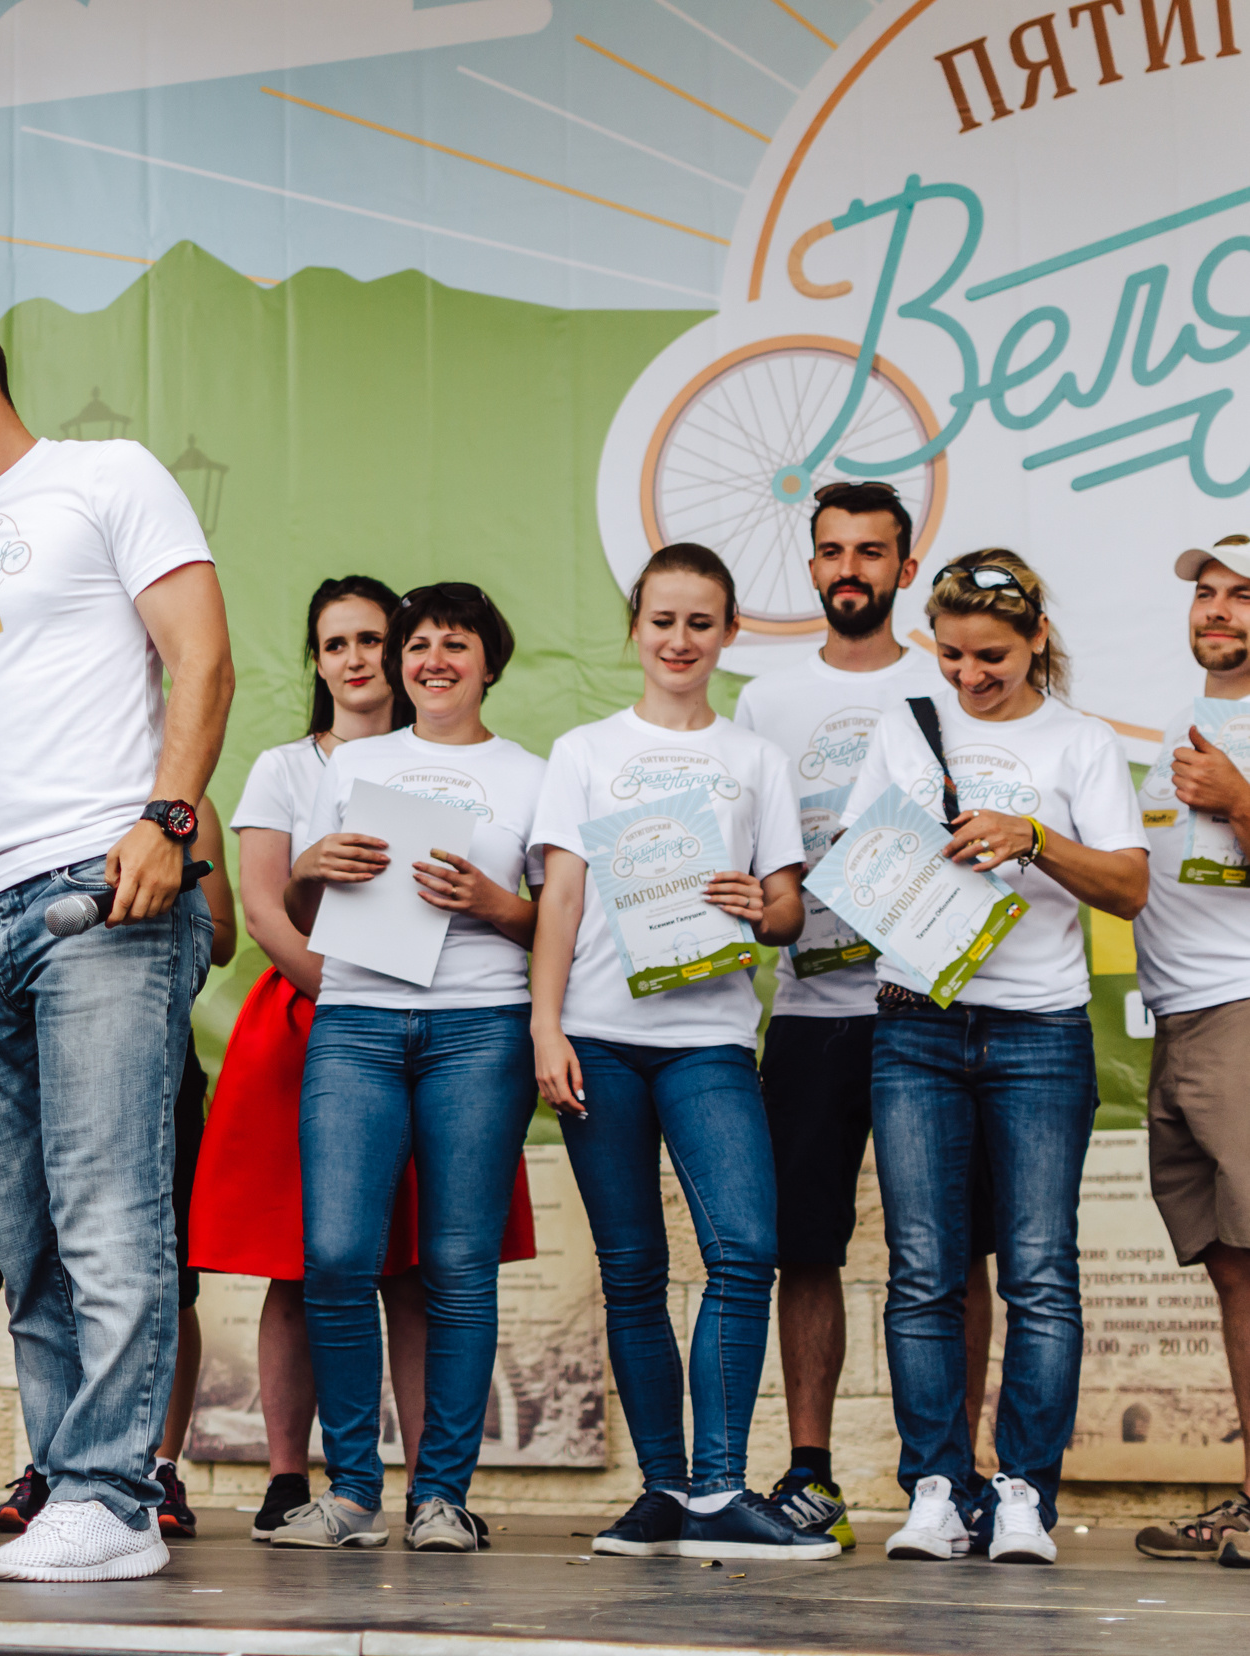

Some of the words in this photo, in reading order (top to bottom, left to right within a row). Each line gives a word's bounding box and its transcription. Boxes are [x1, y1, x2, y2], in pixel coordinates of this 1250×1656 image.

[825, 717, 879, 732] ПЯТИГОРСК
[639, 755, 710, 766] ПЯТИГОРСКИЙ
[949, 754, 1018, 771] ПЯТИГОРСКИЙ
[402, 775, 472, 789] ПЯТИГОРСКИЙ
[614, 868, 717, 910] БЛАГОДАРНОСТ
[875, 849, 947, 936] БЛАГОДАРНОСТ
[648, 918, 675, 931] Ксении
[1080, 1248, 1108, 1260] ние
[1116, 1248, 1166, 1264] озера
[1081, 1272, 1209, 1289] уществляется
[1082, 1296, 1148, 1308] антами
[1103, 1319, 1222, 1334] понедельник
[1127, 1343, 1150, 1357] до
